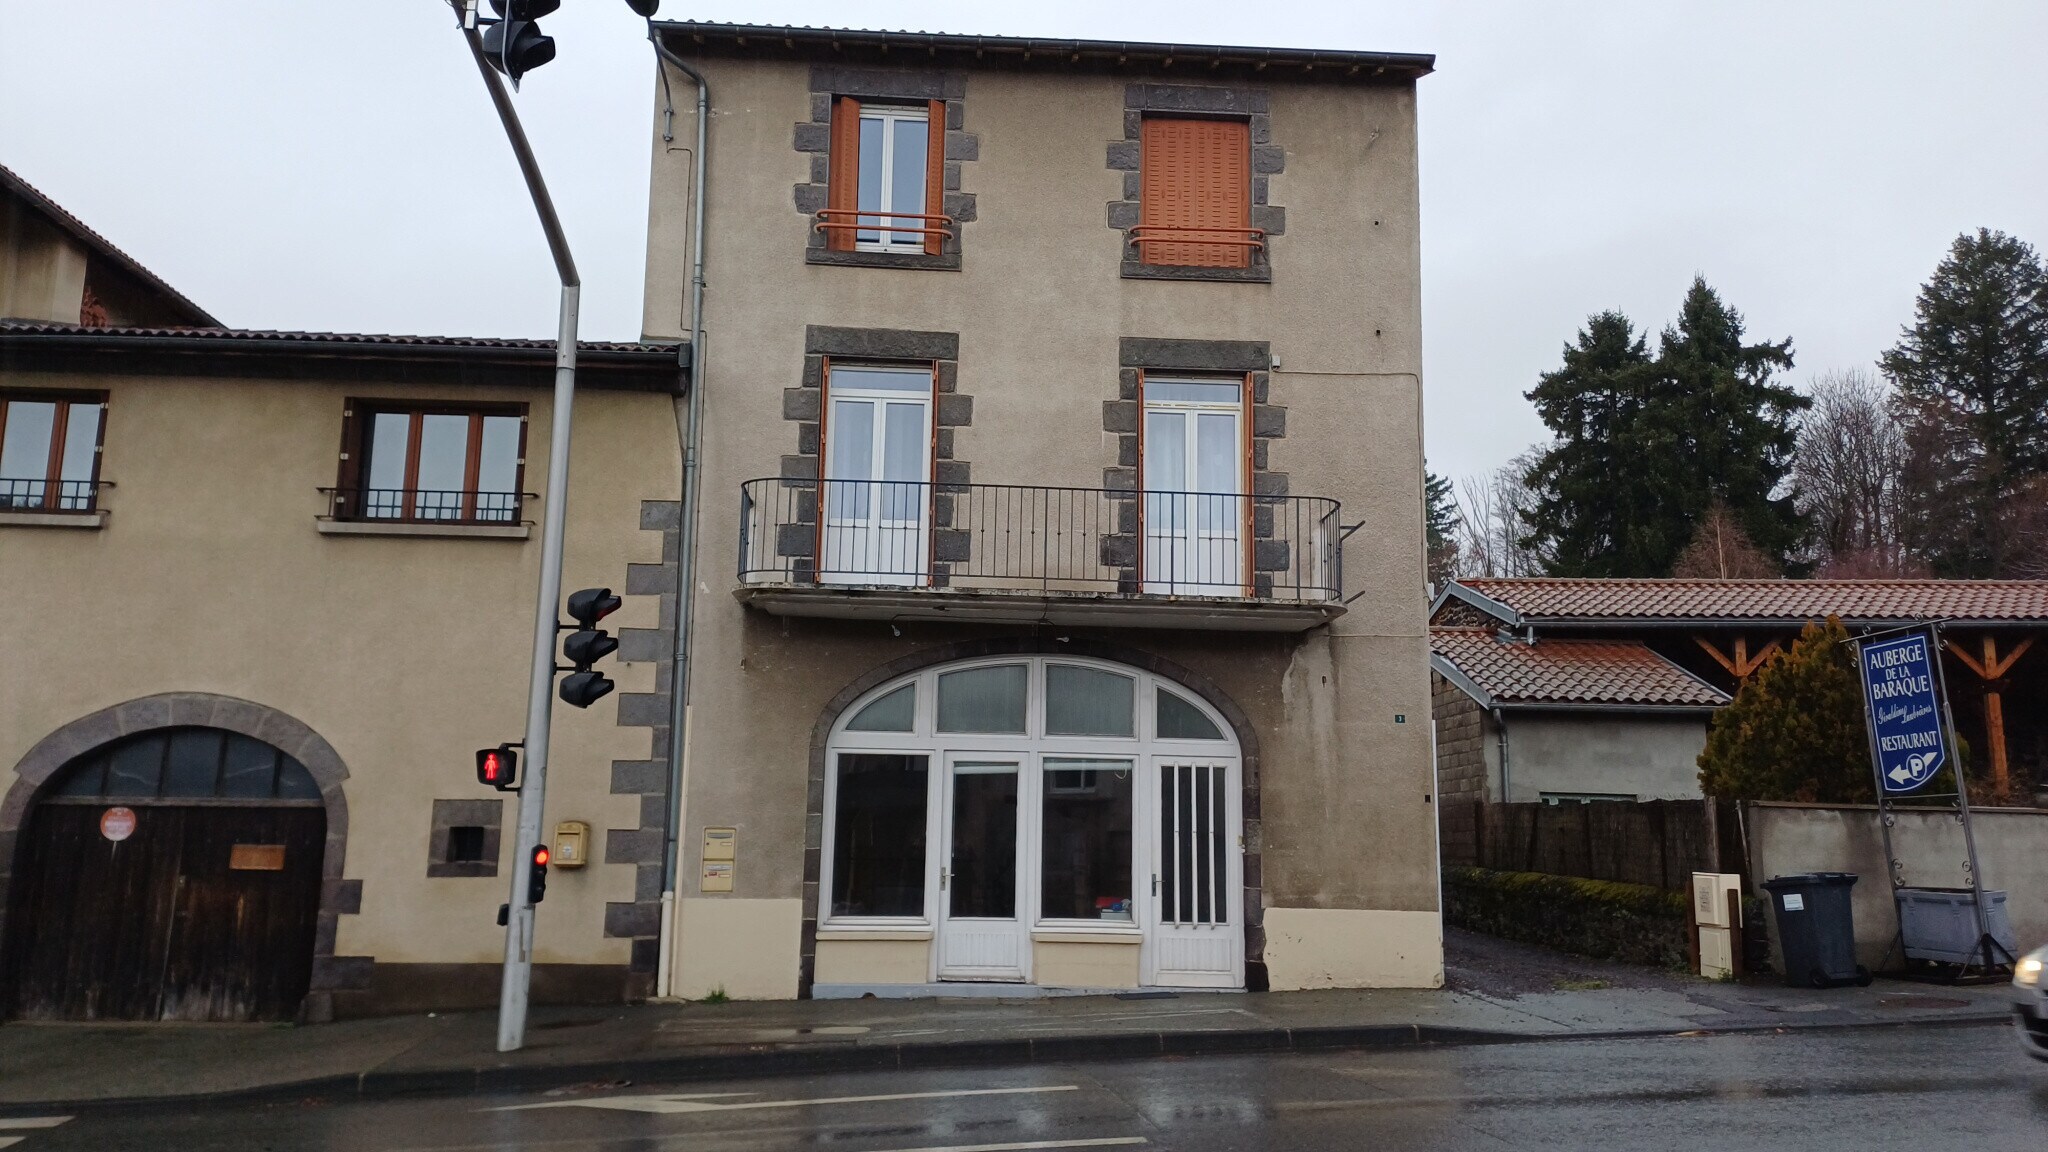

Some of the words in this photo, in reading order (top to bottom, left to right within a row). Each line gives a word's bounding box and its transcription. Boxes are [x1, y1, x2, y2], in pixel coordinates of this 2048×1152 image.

[1870, 644, 1923, 670] AUBERGE
[1885, 668, 1897, 681] DE
[1899, 665, 1911, 679] LA
[1873, 675, 1930, 700] BARAQUE
[1881, 730, 1937, 752] RESTAURANT
[1910, 758, 1924, 777] P
